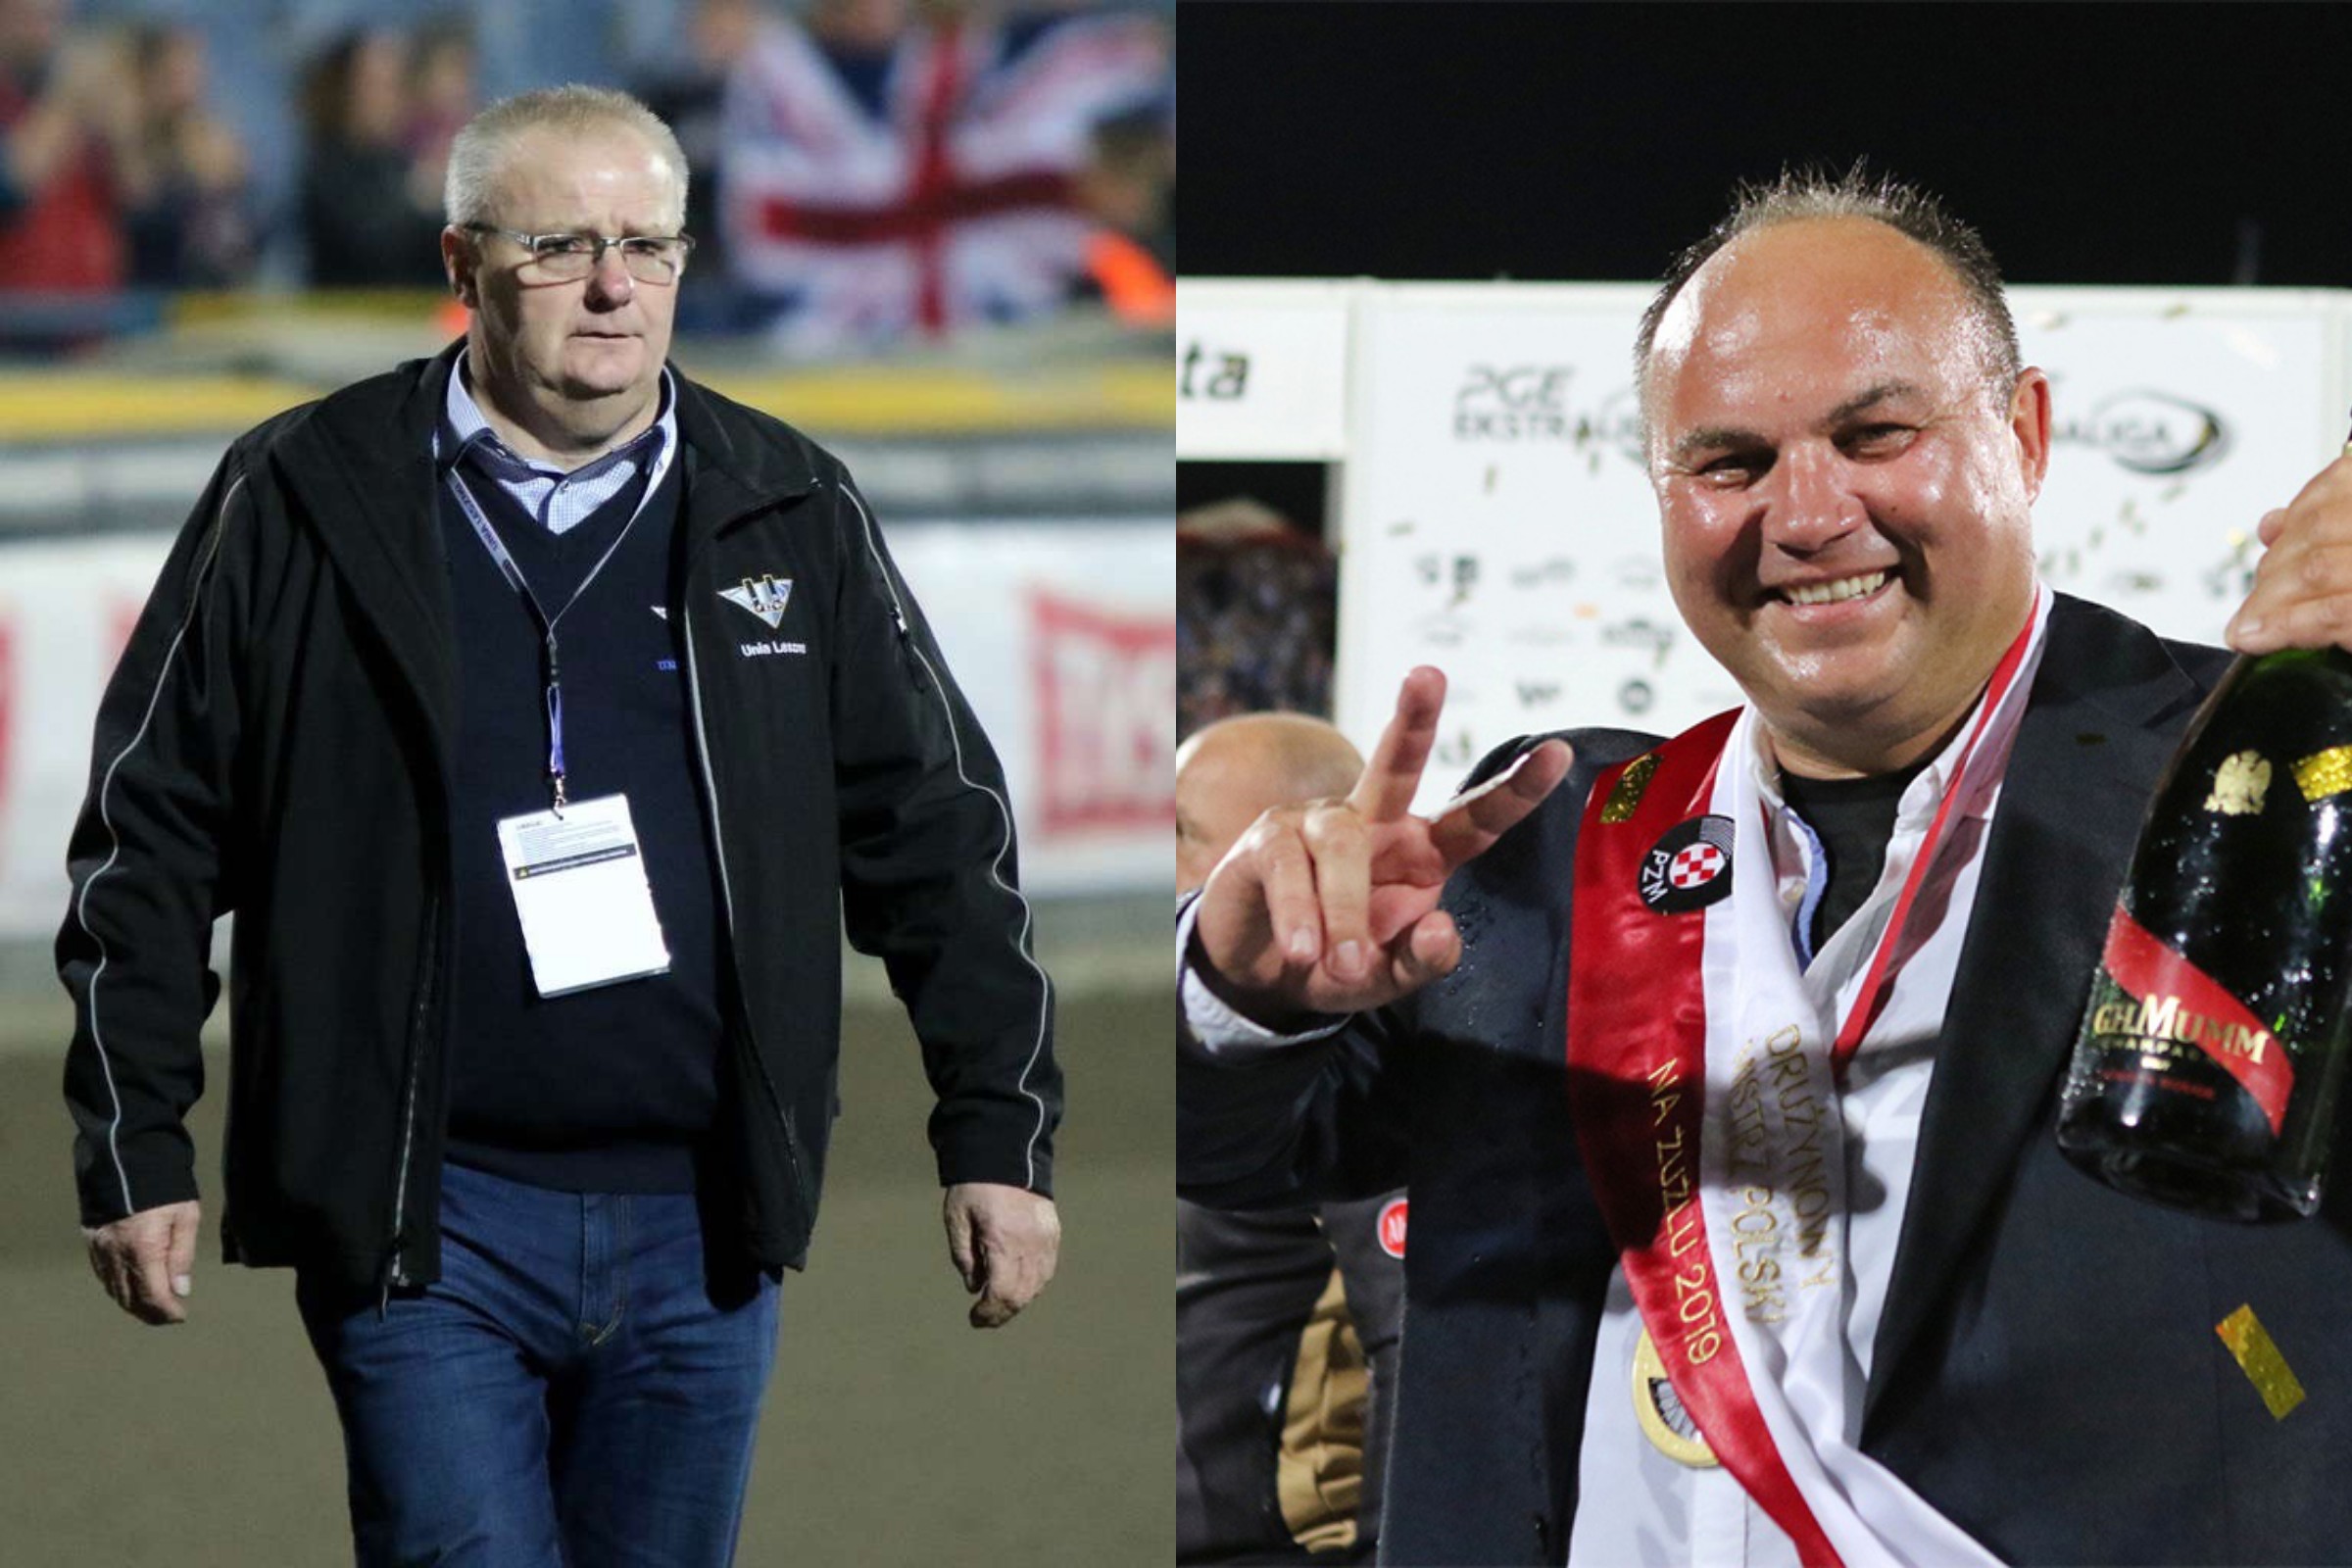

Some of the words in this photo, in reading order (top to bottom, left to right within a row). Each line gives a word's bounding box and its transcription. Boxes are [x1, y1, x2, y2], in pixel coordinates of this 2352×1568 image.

[741, 642, 772, 658] Unia
[1642, 849, 1672, 904] PZM
[1647, 1057, 1682, 1127] NA
[1676, 1263, 1722, 1365] 2019
